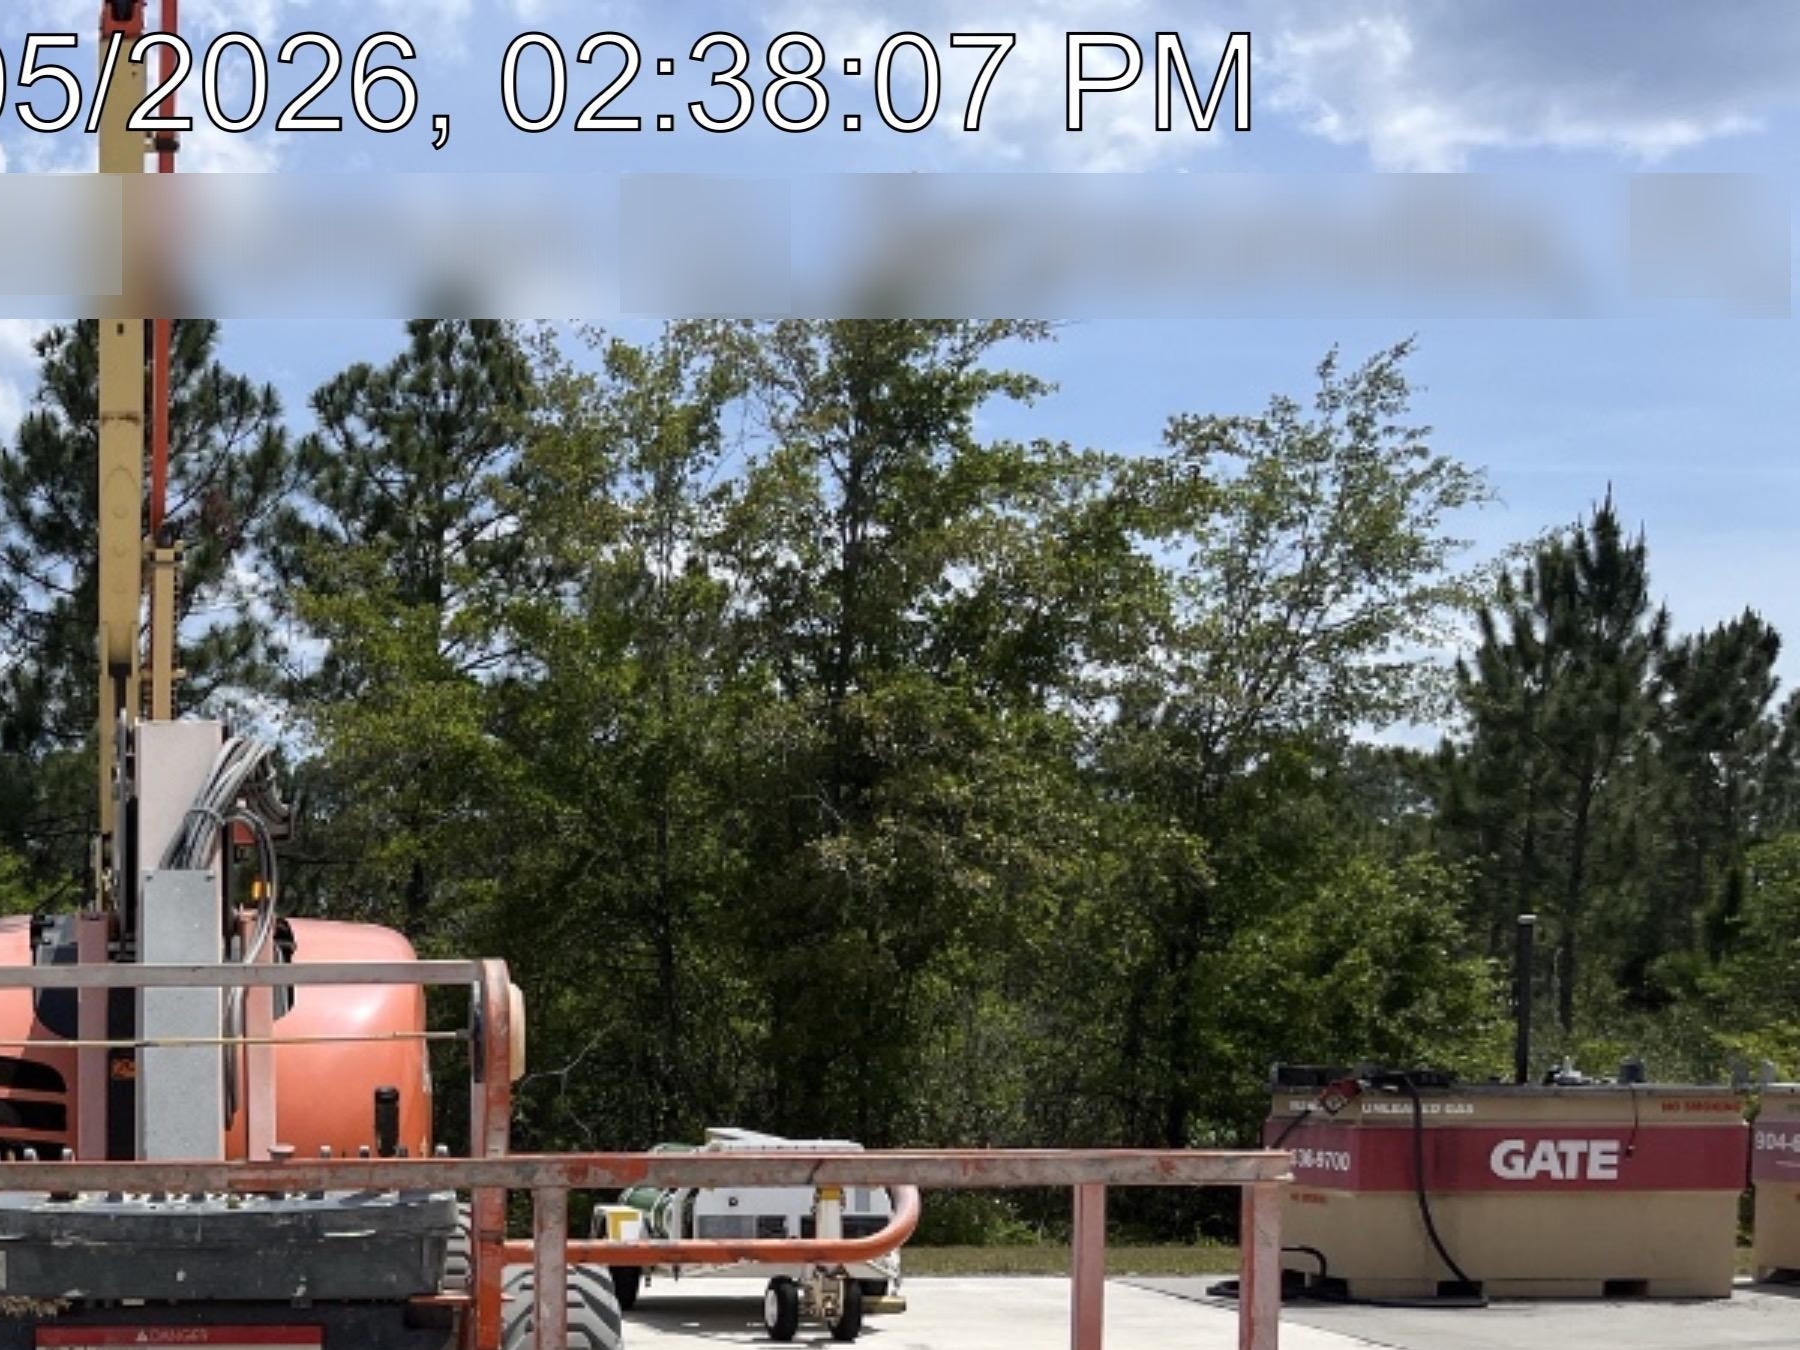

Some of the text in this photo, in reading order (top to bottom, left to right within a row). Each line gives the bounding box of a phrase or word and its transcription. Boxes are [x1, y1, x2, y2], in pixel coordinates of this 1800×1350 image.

[1361, 1101, 1441, 1114] UNLEAED
[1489, 1139, 1620, 1180] GATE
[149, 1328, 208, 1342] DANGER
